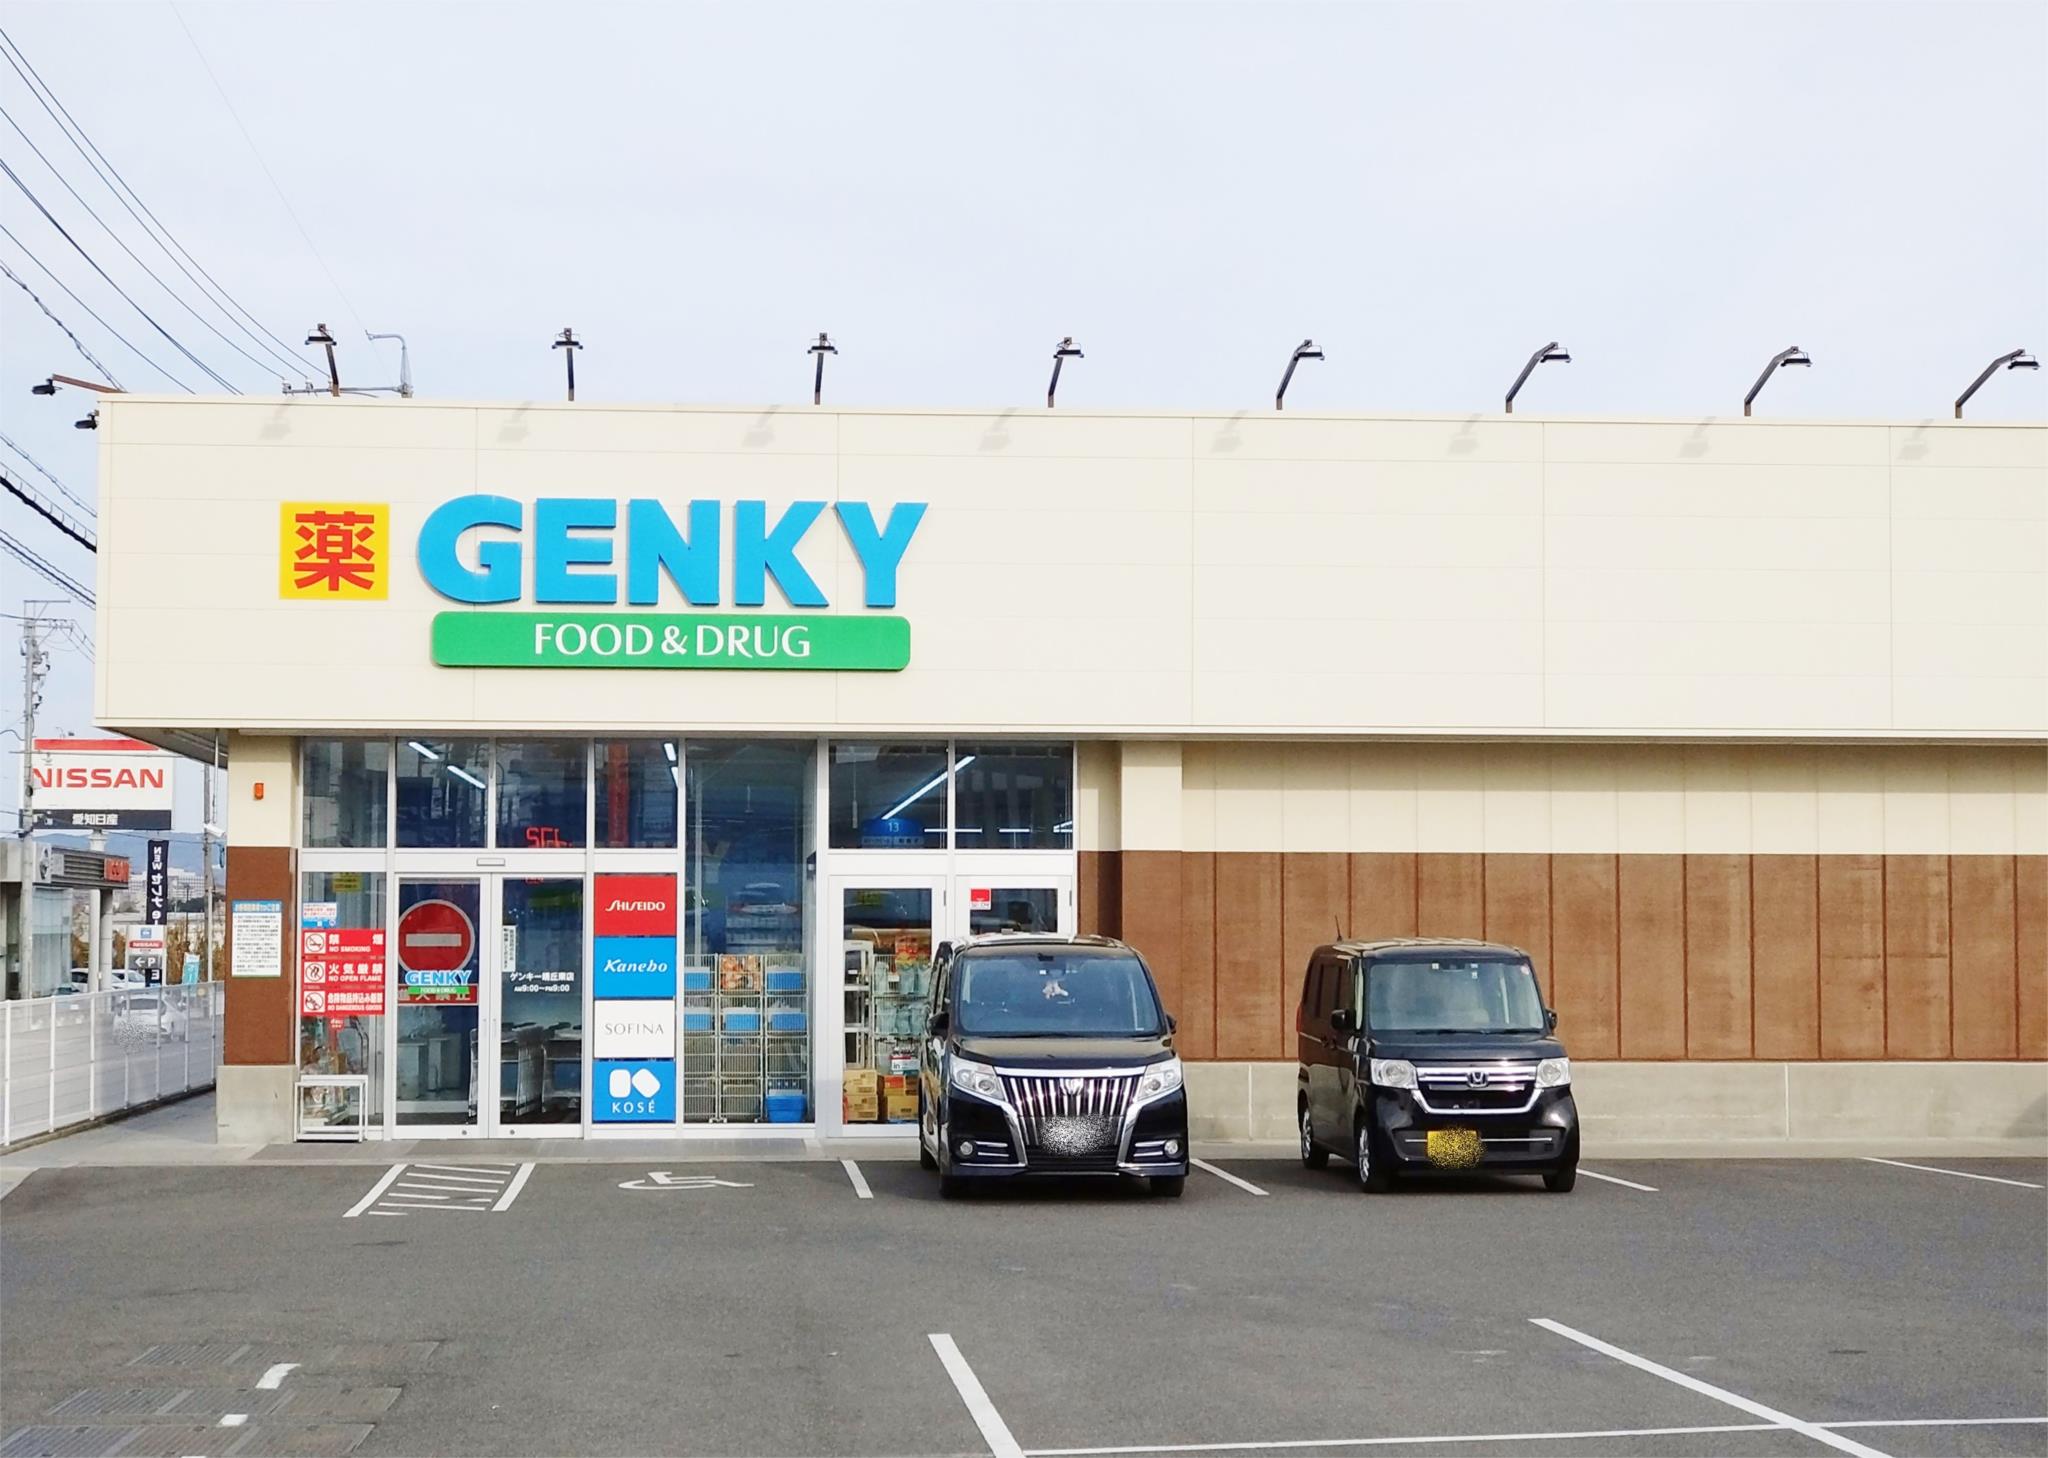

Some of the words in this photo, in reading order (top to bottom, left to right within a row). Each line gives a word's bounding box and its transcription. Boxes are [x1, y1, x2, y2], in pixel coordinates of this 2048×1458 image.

[294, 510, 375, 592] 薬
[417, 494, 928, 608] GENKY
[534, 623, 654, 656] FOOD
[661, 625, 688, 656] &
[696, 624, 811, 658] DRUG
[33, 768, 164, 789] NISSAN
[72, 813, 119, 826] 愛知日産
[605, 899, 666, 912] SHISEIDO
[604, 959, 669, 973] Kanebo
[405, 970, 472, 986] GENKY
[605, 1023, 664, 1035] SOFINA
[612, 1100, 655, 1113] KOSÉ
